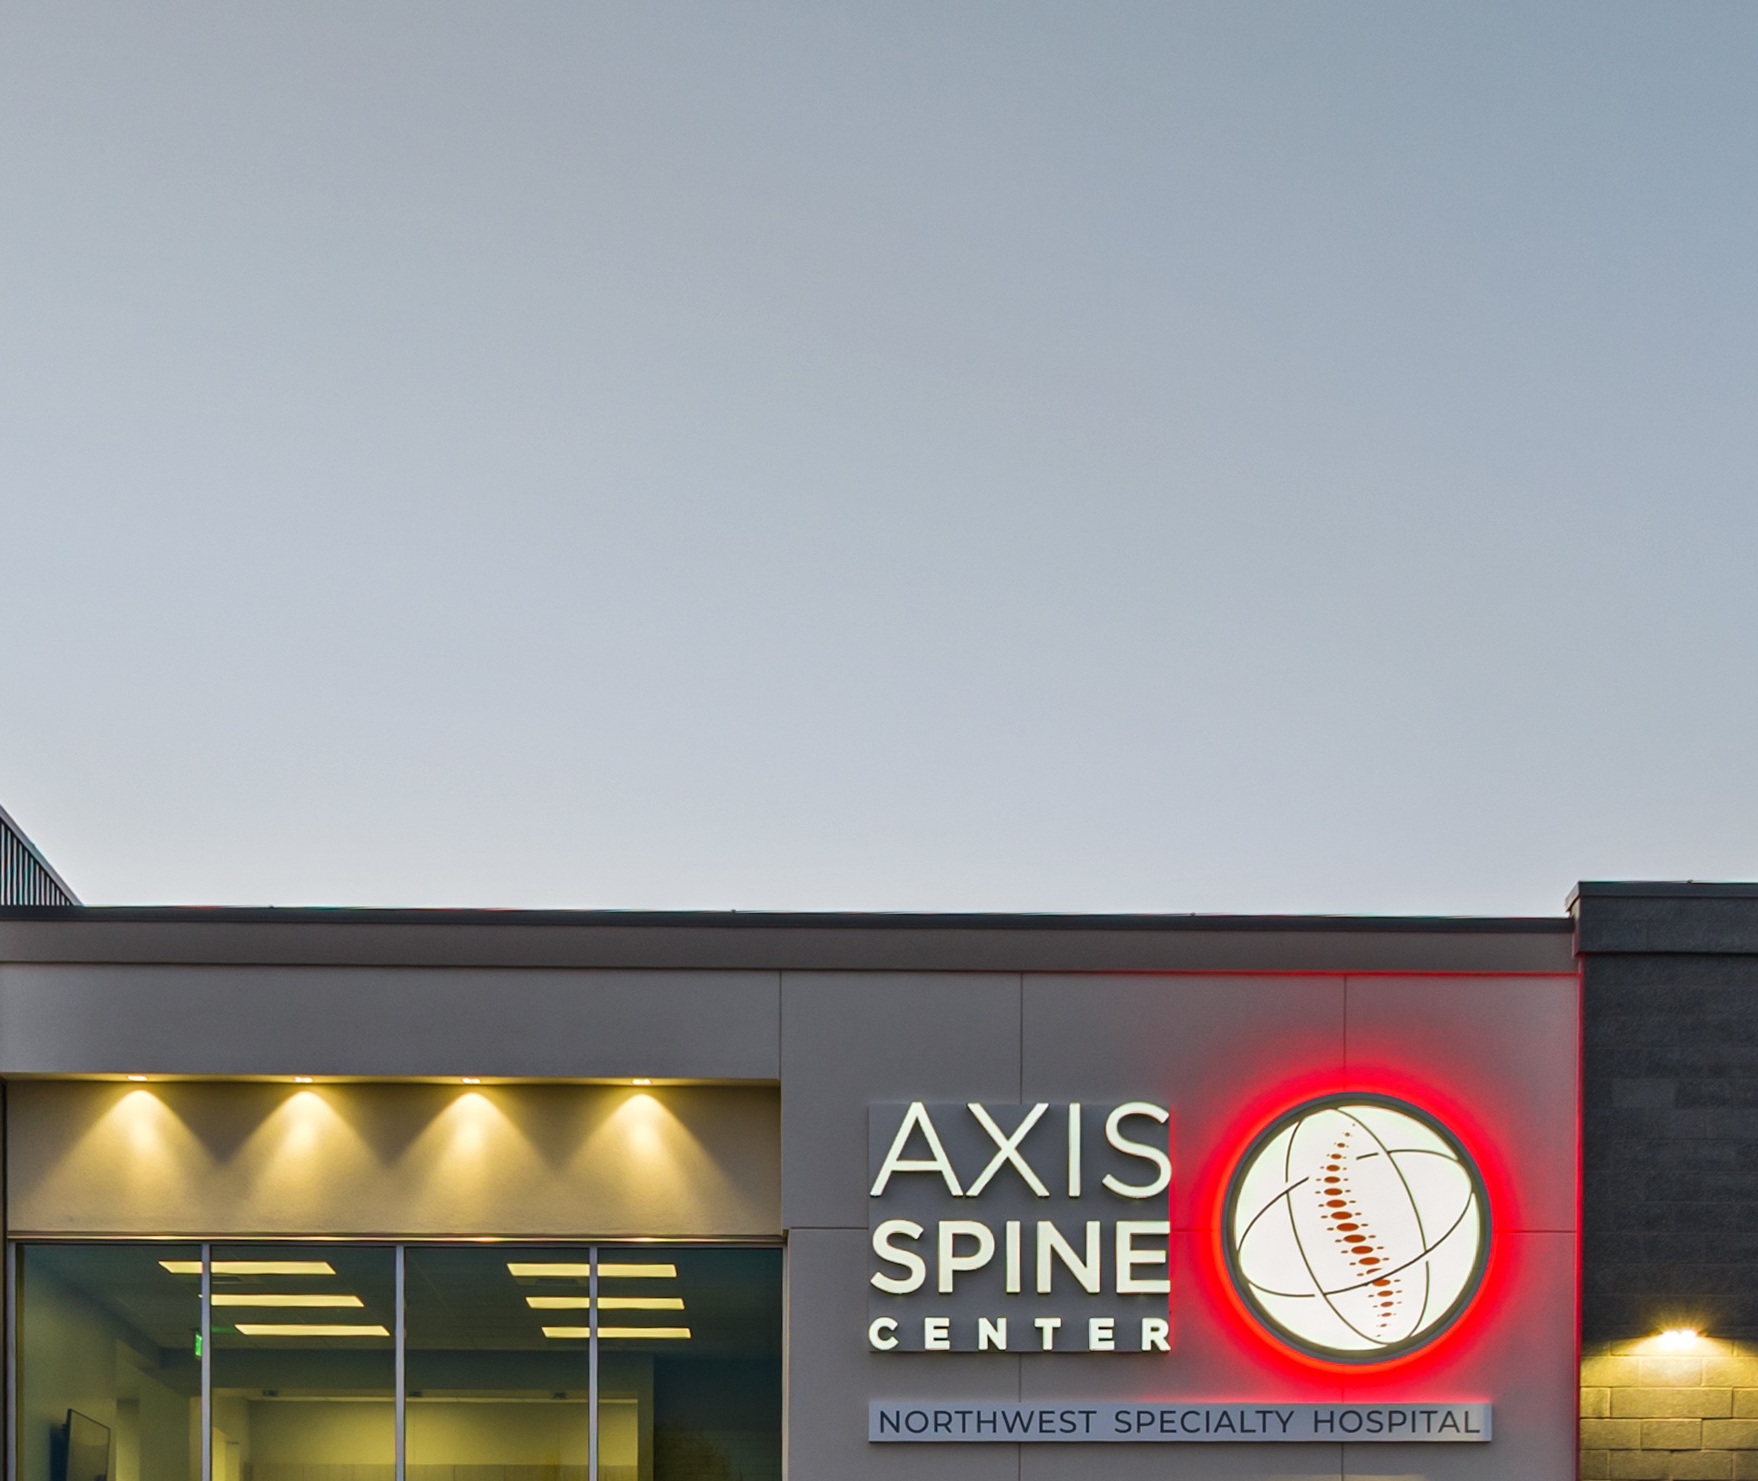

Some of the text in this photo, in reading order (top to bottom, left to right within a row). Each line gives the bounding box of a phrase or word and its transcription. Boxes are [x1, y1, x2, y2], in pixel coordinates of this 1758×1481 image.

[870, 1102, 1171, 1198] AXIS
[870, 1220, 1171, 1294] SPINE
[868, 1317, 1171, 1350] CENTER
[879, 1410, 1480, 1434] NORTHWEST SPECIALTY HOSPITAL
